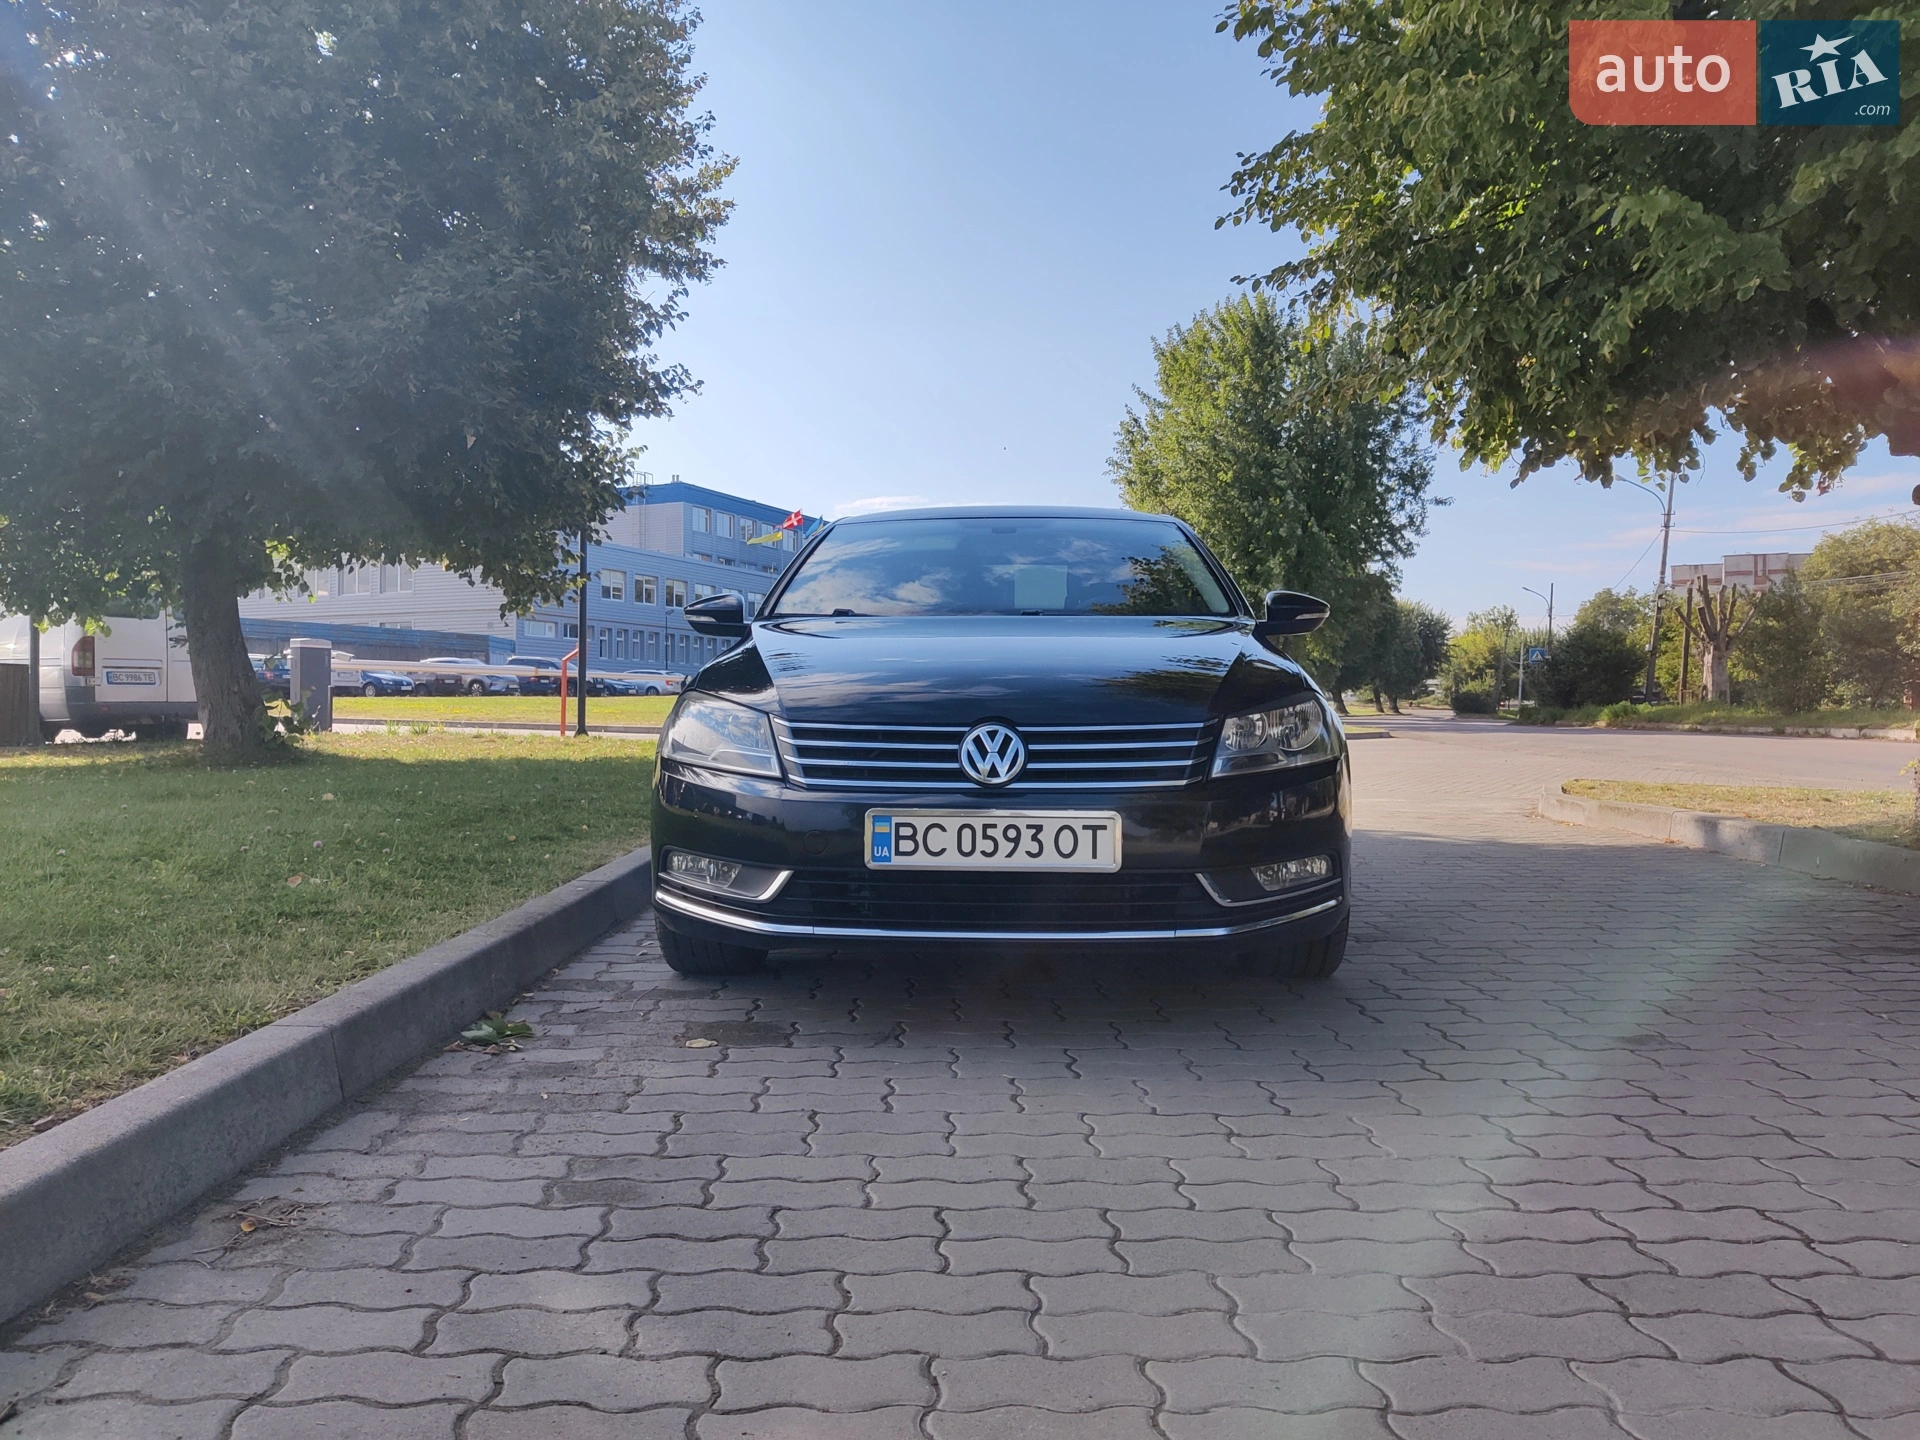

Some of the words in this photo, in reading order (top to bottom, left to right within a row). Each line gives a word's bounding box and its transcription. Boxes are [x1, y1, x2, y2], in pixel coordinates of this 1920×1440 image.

[874, 846, 890, 857] UA
[894, 822, 947, 857] BC
[956, 823, 1045, 859] 0593
[1053, 824, 1108, 860] OT
